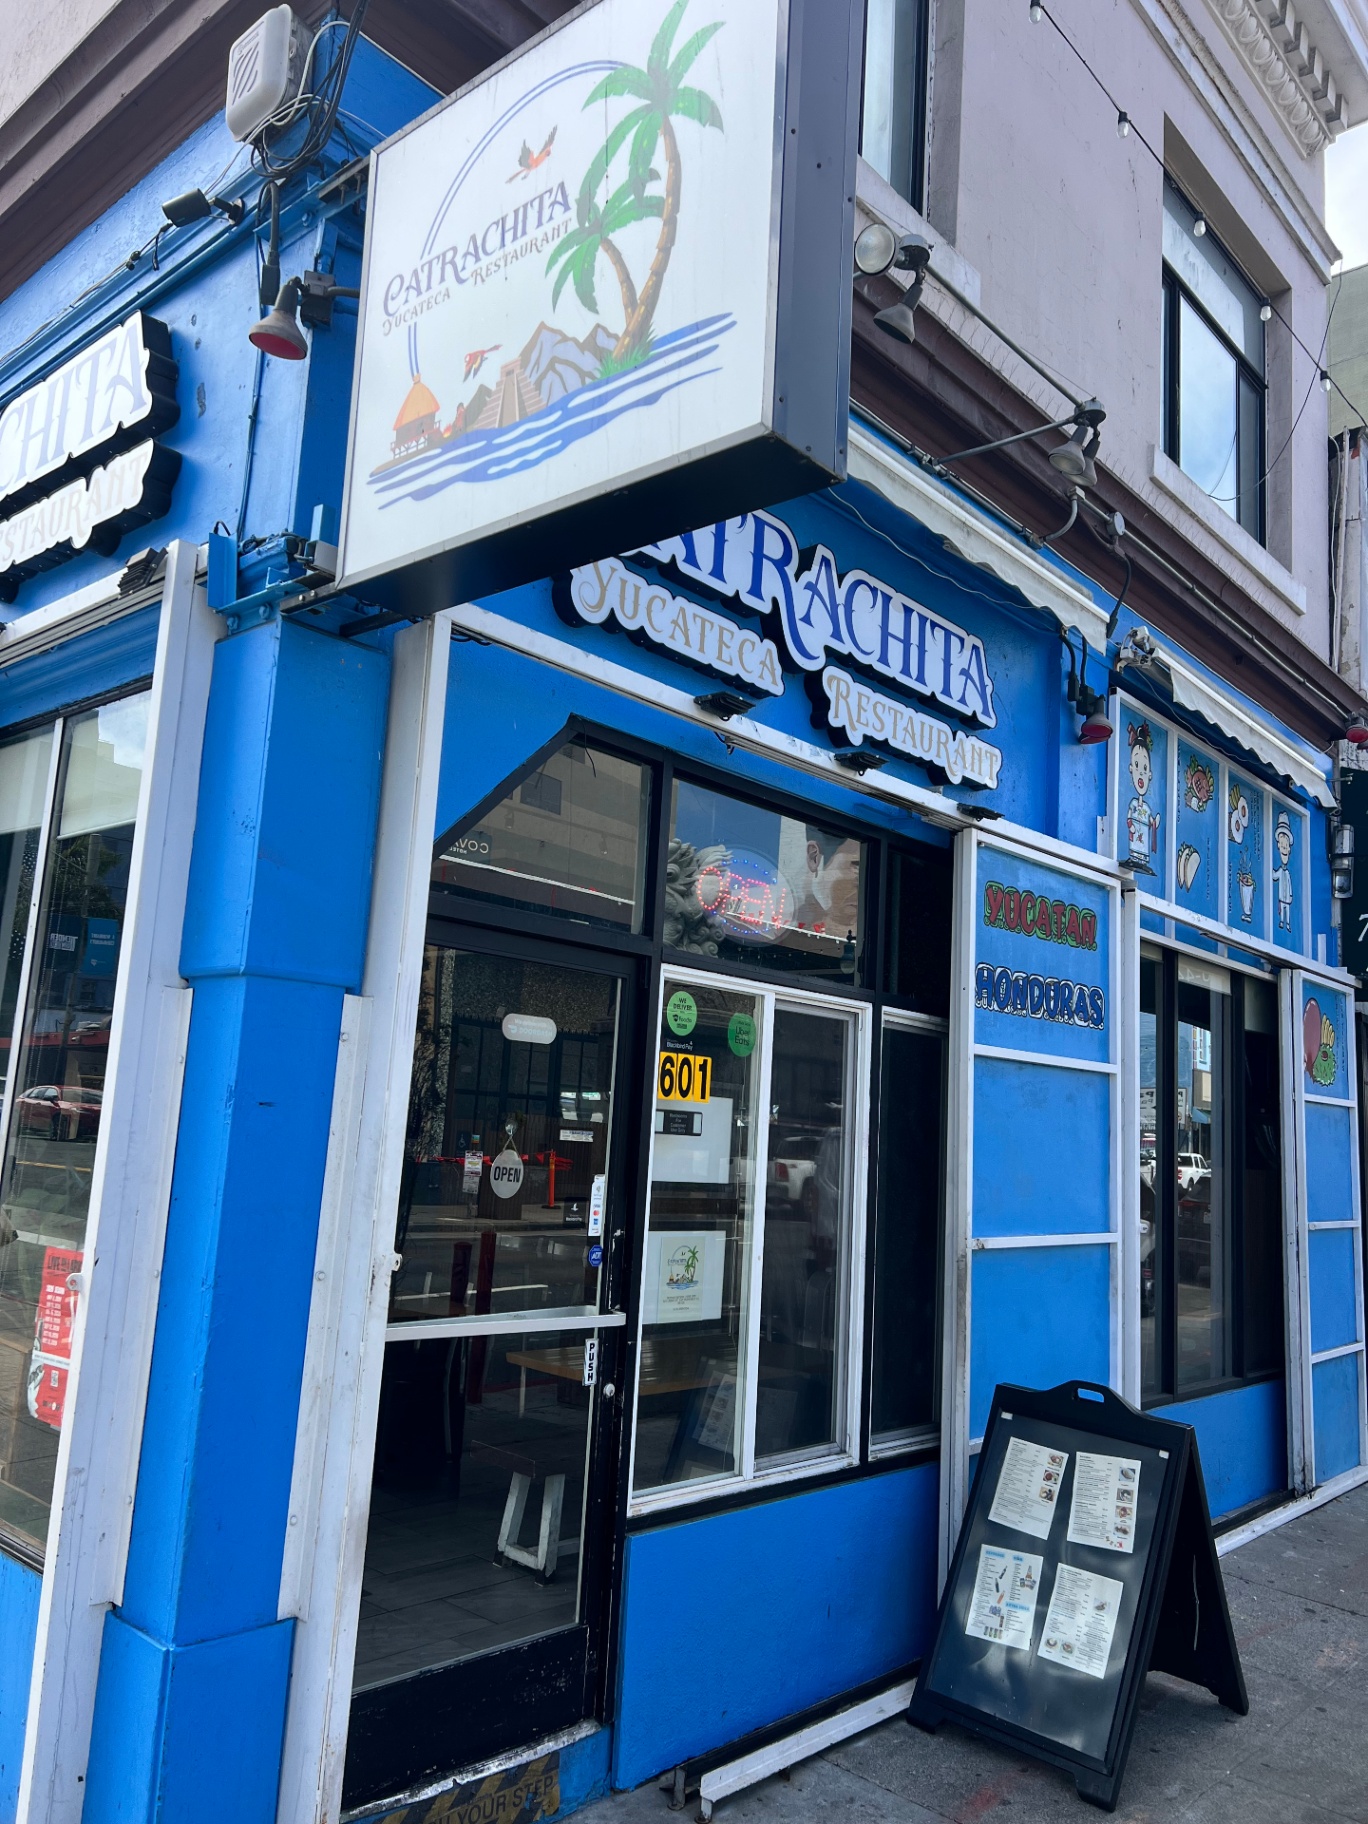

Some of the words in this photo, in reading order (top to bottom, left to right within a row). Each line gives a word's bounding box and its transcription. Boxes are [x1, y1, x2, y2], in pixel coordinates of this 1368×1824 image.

[383, 180, 572, 318] CATRACHITA
[470, 218, 572, 286] RESTAURANT
[382, 287, 451, 337] YUCATECA
[0, 451, 148, 562] STAURANT
[577, 559, 783, 688] YUCATECA
[638, 511, 997, 721] TRACHITA
[826, 673, 999, 778] RESTAURANT
[696, 866, 787, 929] OPEN
[984, 881, 1098, 951] YUCATAN
[975, 962, 1105, 1030] HONDURAS
[734, 1035, 750, 1047] Eats
[735, 1025, 750, 1036] Uber
[660, 1055, 709, 1100] 601
[494, 1166, 522, 1183] OPEN
[587, 1342, 596, 1382] PUSH
[457, 1794, 507, 1824] YOUR
[512, 1775, 555, 1808] STEP
